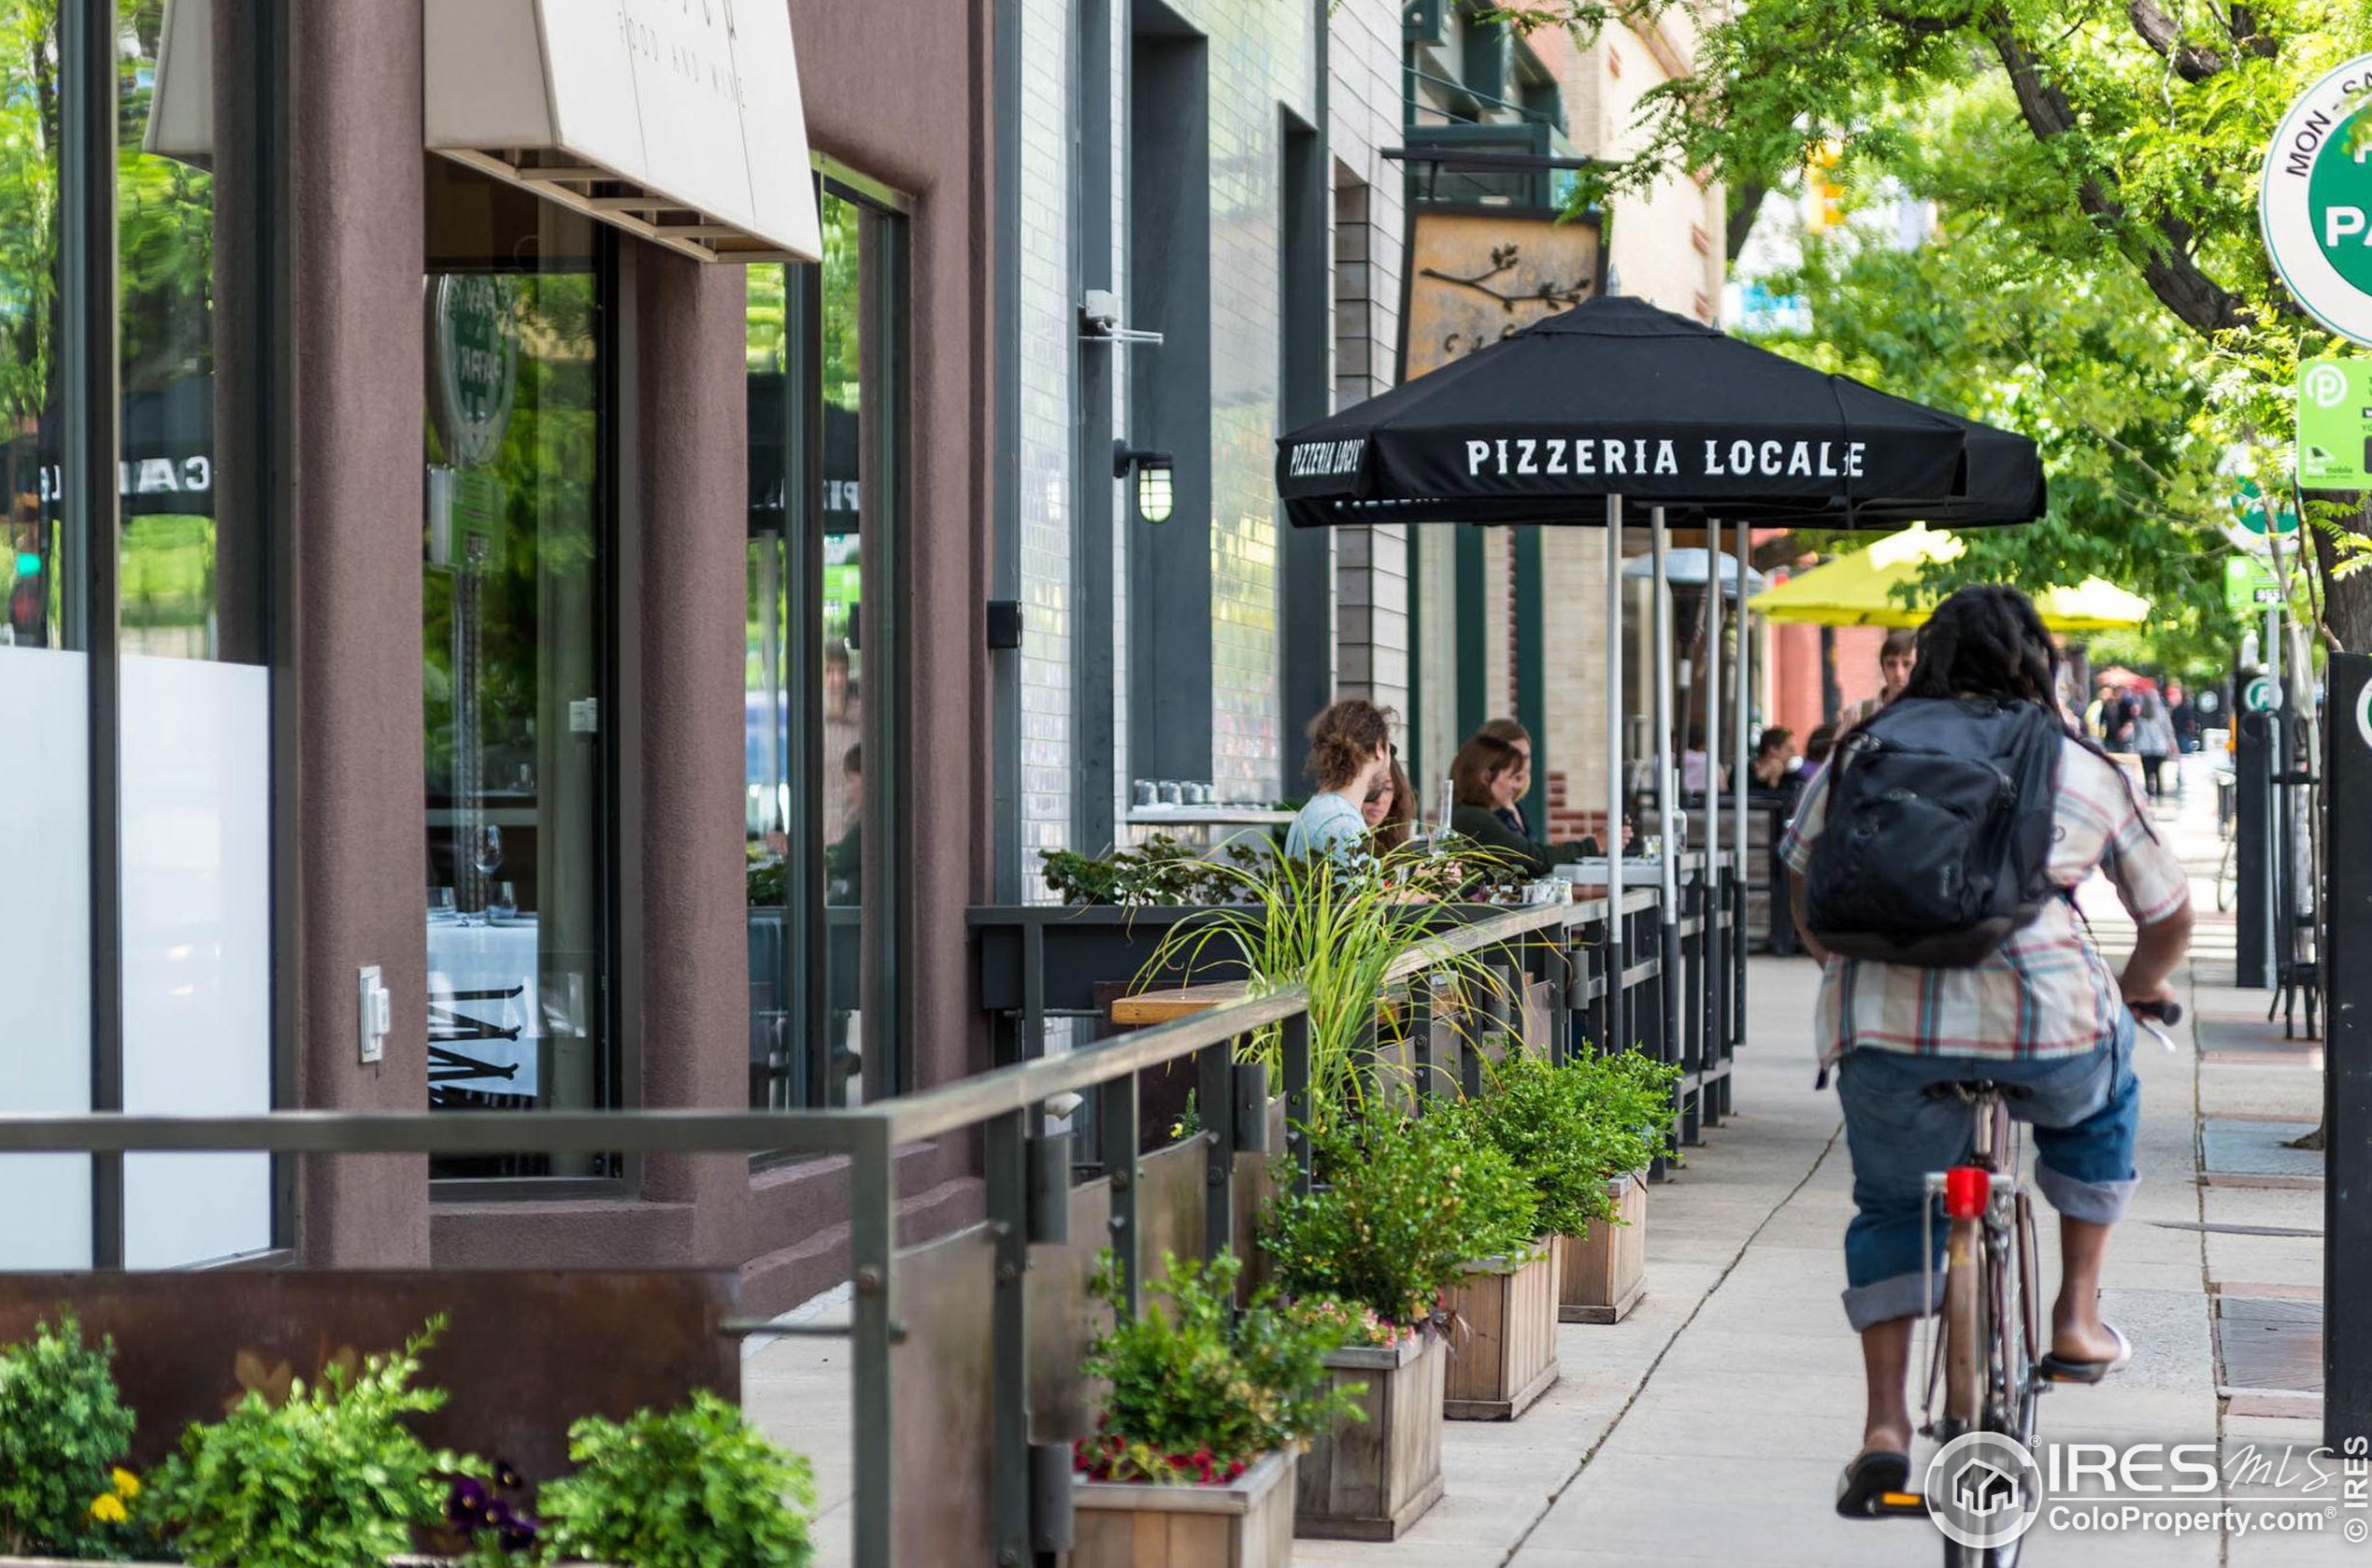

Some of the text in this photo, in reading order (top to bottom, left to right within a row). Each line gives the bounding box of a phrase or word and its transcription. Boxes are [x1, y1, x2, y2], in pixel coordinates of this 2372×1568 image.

[2286, 109, 2331, 178] MON
[2326, 206, 2372, 247] P
[1289, 441, 1336, 478] PIZZERIA
[1466, 438, 1866, 478] PIZZERIA LOCALE
